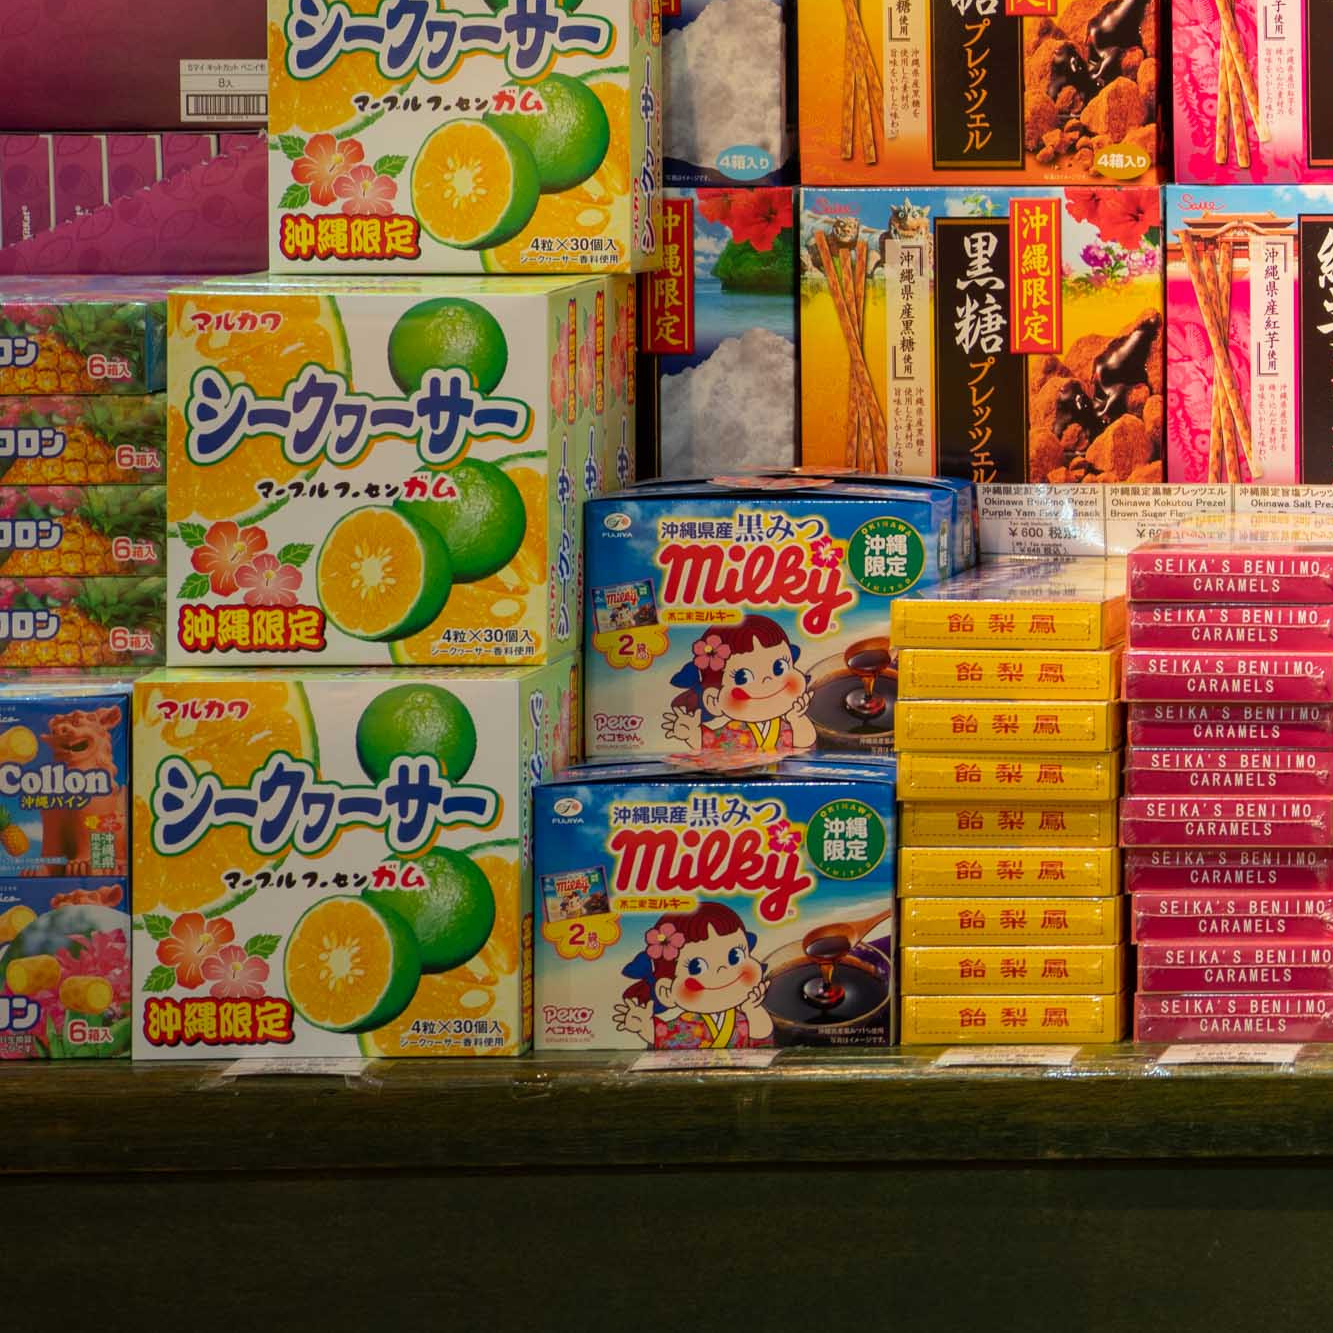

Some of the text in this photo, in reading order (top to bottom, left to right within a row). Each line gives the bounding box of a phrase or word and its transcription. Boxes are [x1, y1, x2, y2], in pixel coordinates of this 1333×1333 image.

[284, 216, 416, 258] 沖縄限定
[1021, 208, 1051, 346] 沖縄限定
[955, 231, 1006, 354] 黒糖
[190, 311, 283, 332] マルカワ
[193, 372, 520, 456] シークヮーサー
[1111, 498, 1227, 508] Okinawa Kokutou Prezel
[1250, 499, 1290, 509] Okinawa
[1292, 499, 1311, 509] Salt
[661, 513, 825, 542] 沖縄県産黒みつ
[863, 534, 908, 555] 沖縄
[863, 555, 908, 578] 限定
[1154, 558, 1320, 575] SEIKA'S BENIIMO
[1192, 578, 1282, 593] CARAMELS
[180, 607, 322, 648] 沖縄限定
[156, 699, 250, 720] マルカワ
[1, 765, 110, 795] Collon
[161, 761, 489, 846] シークヮーサー
[613, 796, 783, 826] 沖縄県産黒みつ
[823, 817, 868, 840] 沖縄
[823, 840, 868, 862] 限定
[1165, 949, 1332, 965] SEIKA'S BENIIMO
[1203, 968, 1293, 983] CARAMELS
[148, 1000, 291, 1041] 沖縄限定
